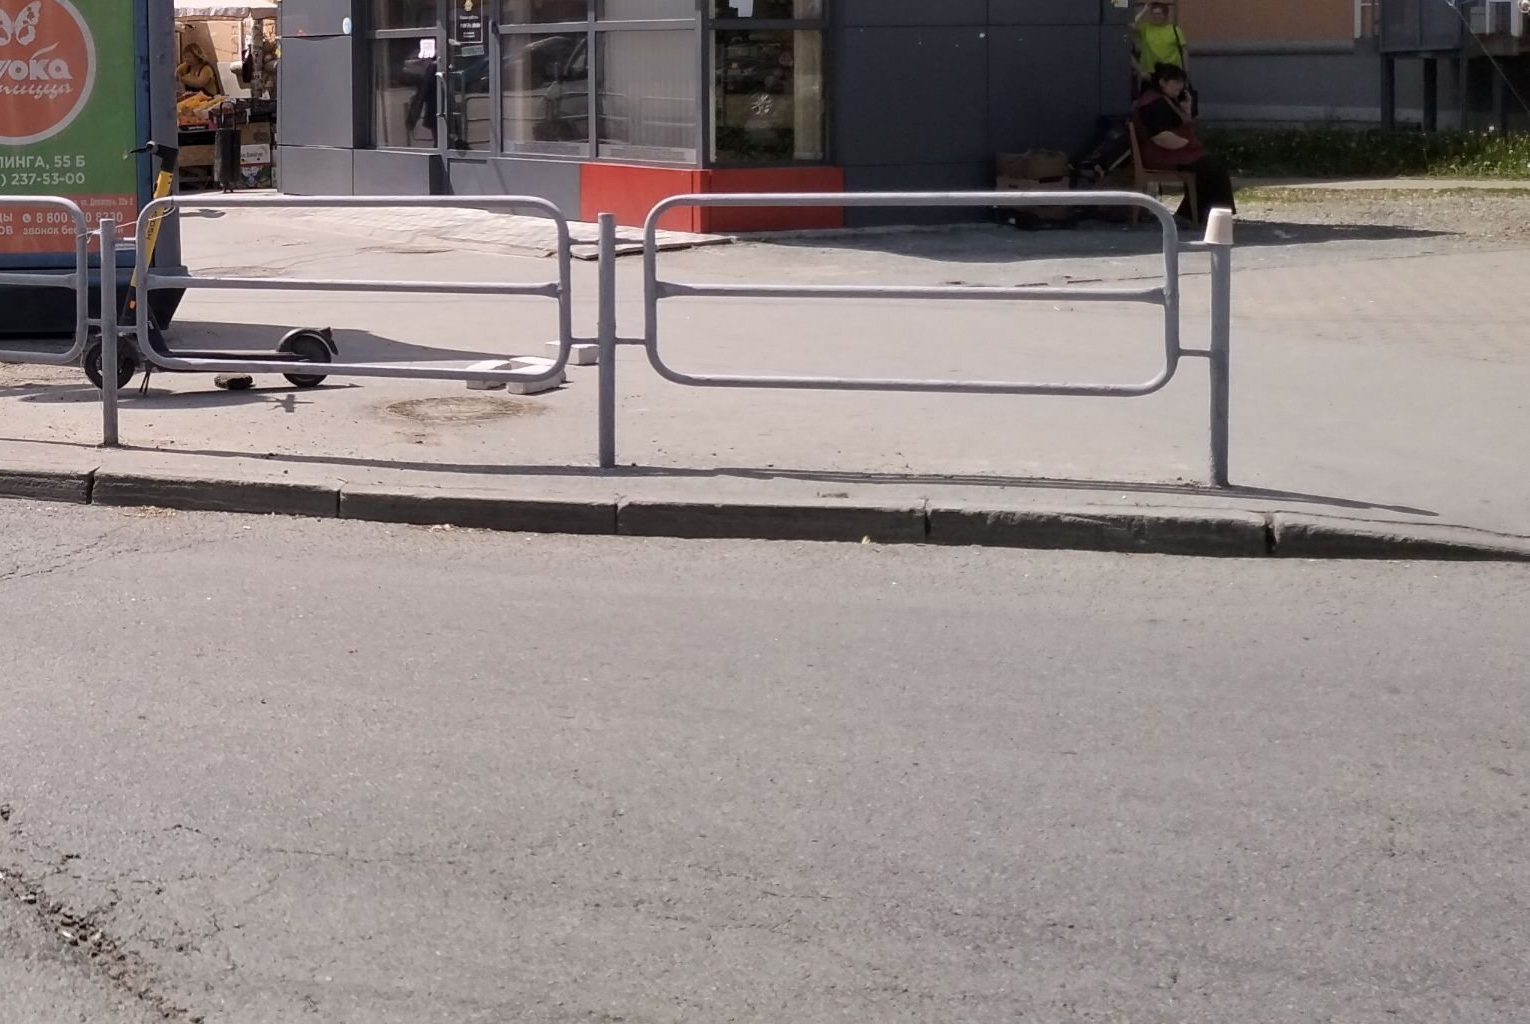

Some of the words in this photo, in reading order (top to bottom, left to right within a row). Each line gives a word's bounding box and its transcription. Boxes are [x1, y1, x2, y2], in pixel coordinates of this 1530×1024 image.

[54, 155, 71, 168] 55
[75, 155, 85, 168] Б
[11, 172, 85, 185] 237-53-00
[36, 212, 43, 223] 8
[47, 212, 68, 223] 800
[23, 226, 59, 235] звонок
